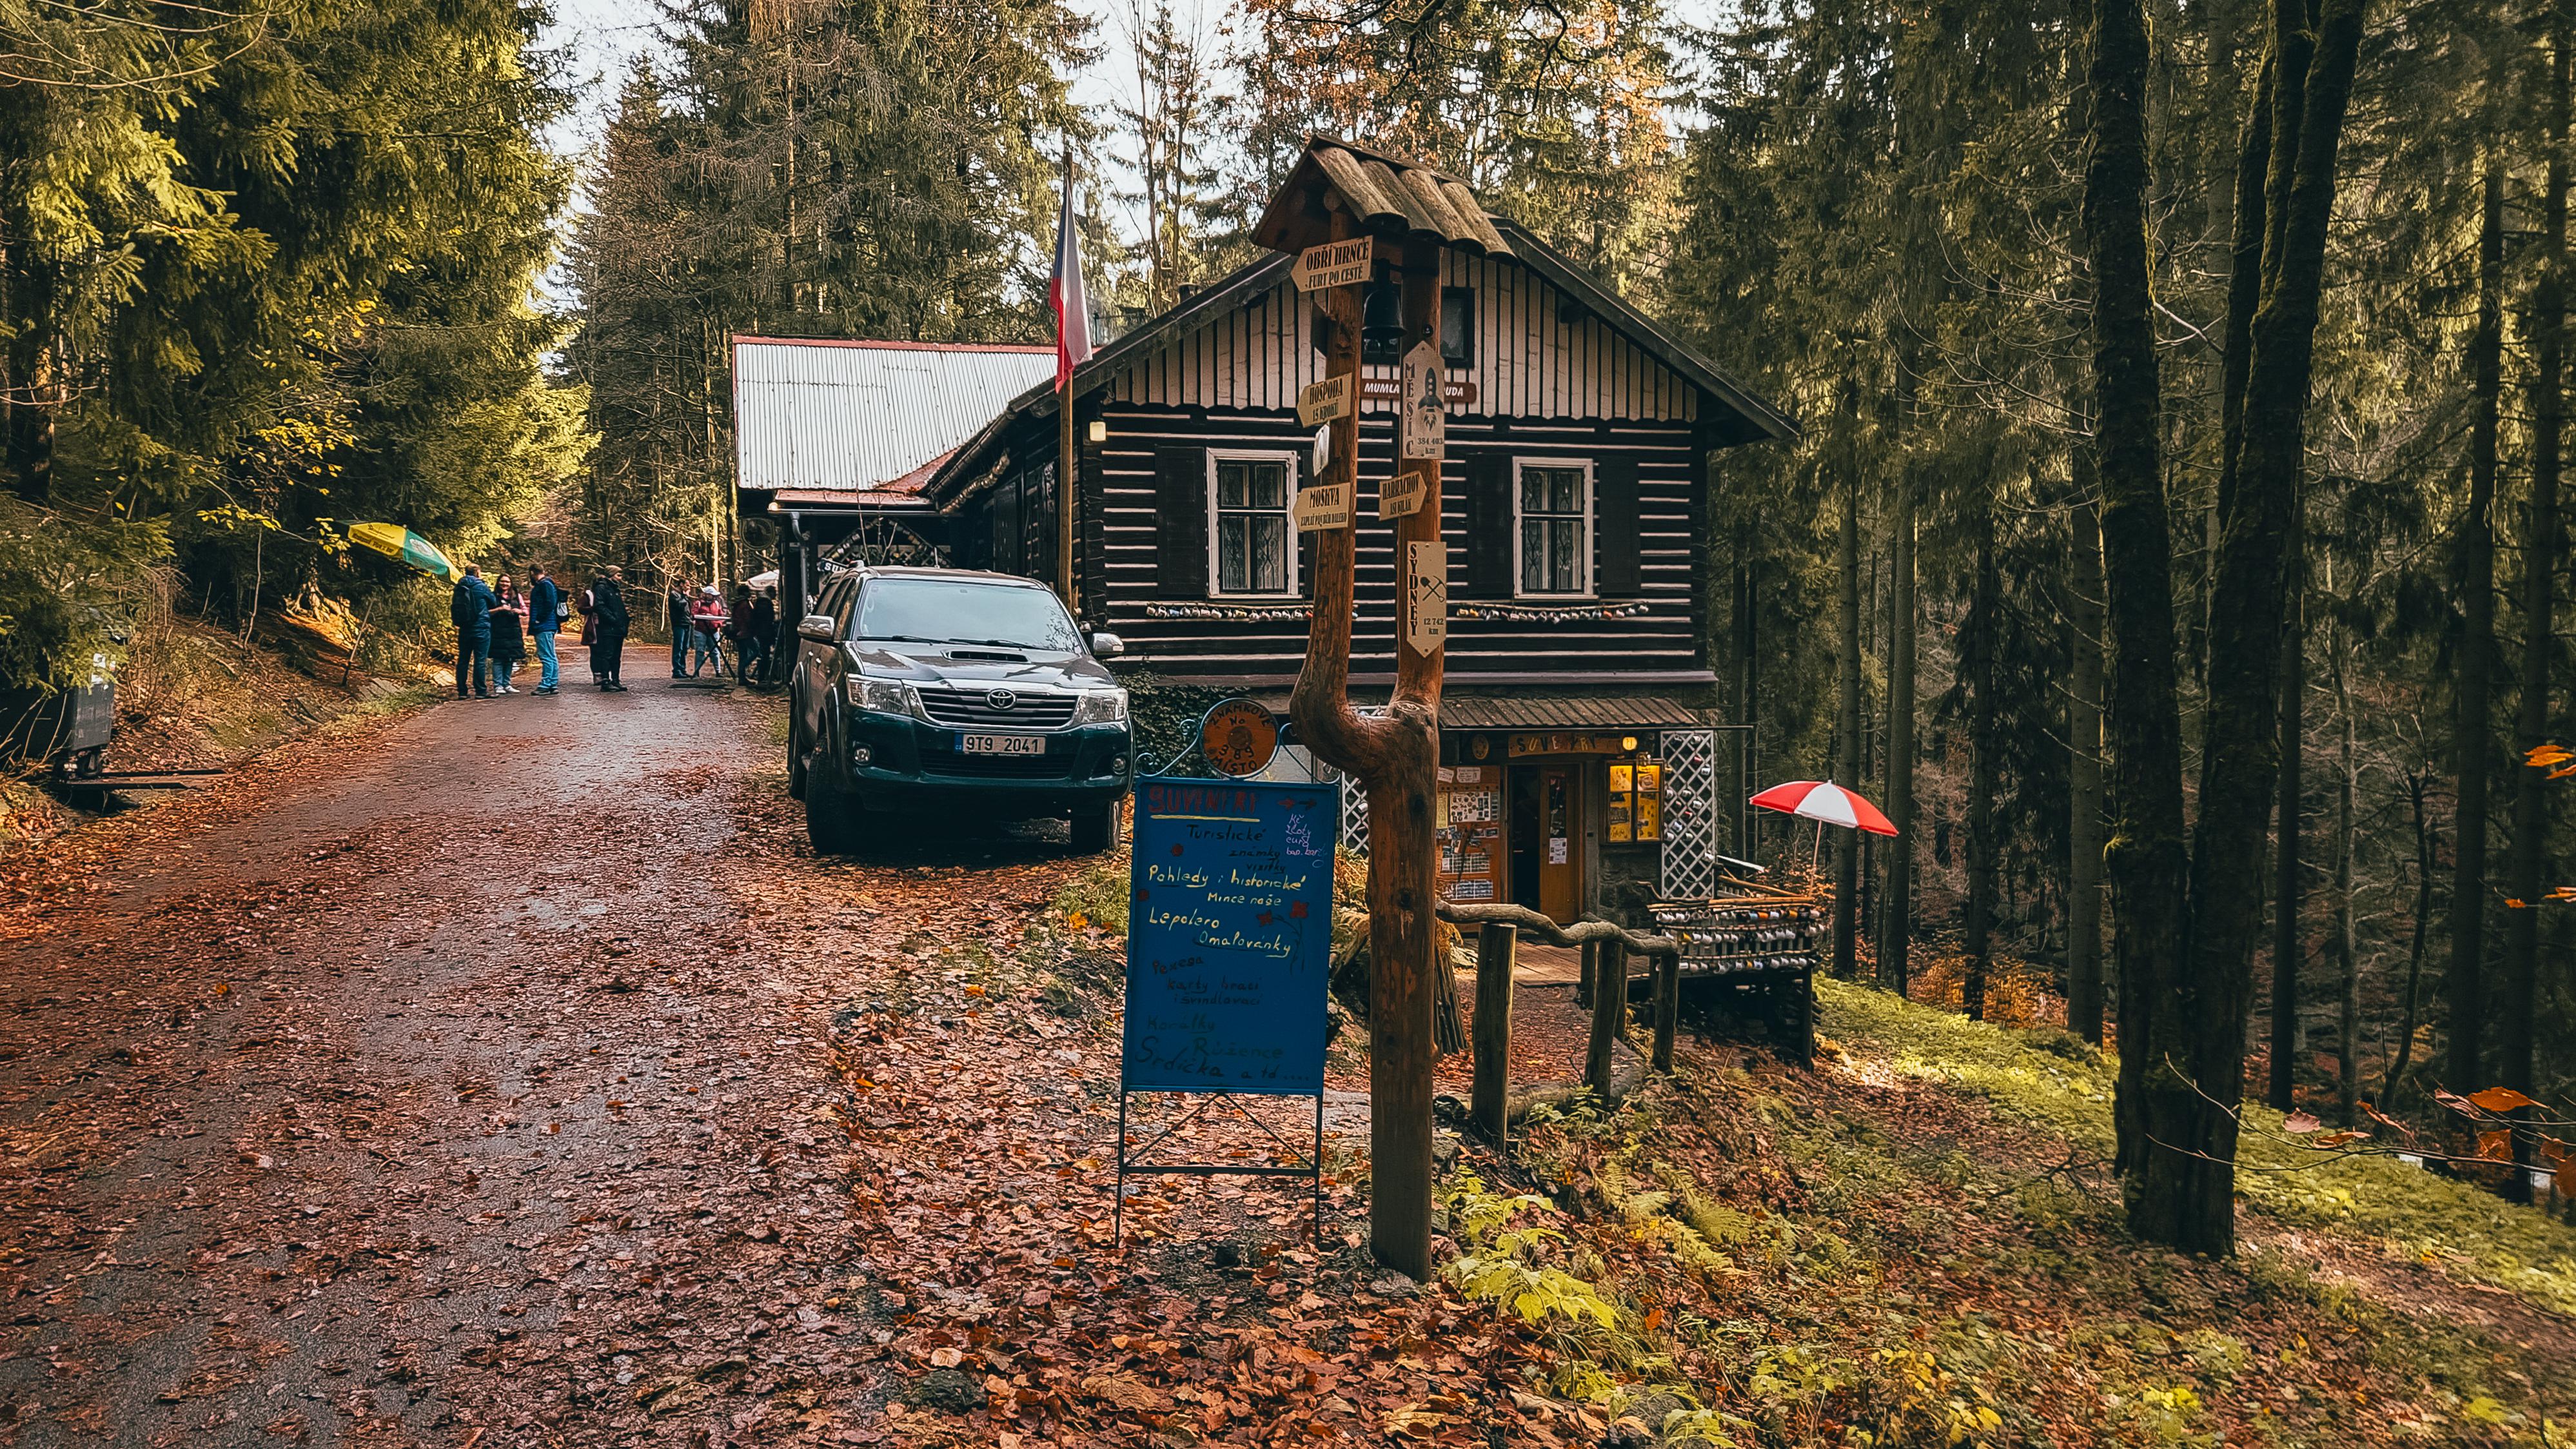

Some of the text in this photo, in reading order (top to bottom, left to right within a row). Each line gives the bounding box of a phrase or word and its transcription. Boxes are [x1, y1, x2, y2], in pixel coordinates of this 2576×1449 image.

[1306, 242, 1369, 270] OBŘÍ HRNCE
[1308, 263, 1362, 288] FURT PO CESTĚ
[1310, 378, 1342, 405] HOSPODA
[1364, 382, 1464, 397] MUMLA UDA
[1405, 363, 1415, 455] MĚSÍC
[1310, 487, 1339, 508] MOSKVA
[1382, 474, 1419, 500] HARRACHOV
[1409, 544, 1419, 636] SYDNEY
[967, 736, 1038, 753] 9T9 2041
[1149, 865, 1208, 887] Pohledy
[1231, 869, 1306, 891] historické
[1207, 892, 1282, 906] Mince naše
[1199, 931, 1291, 958] Omalovánky
